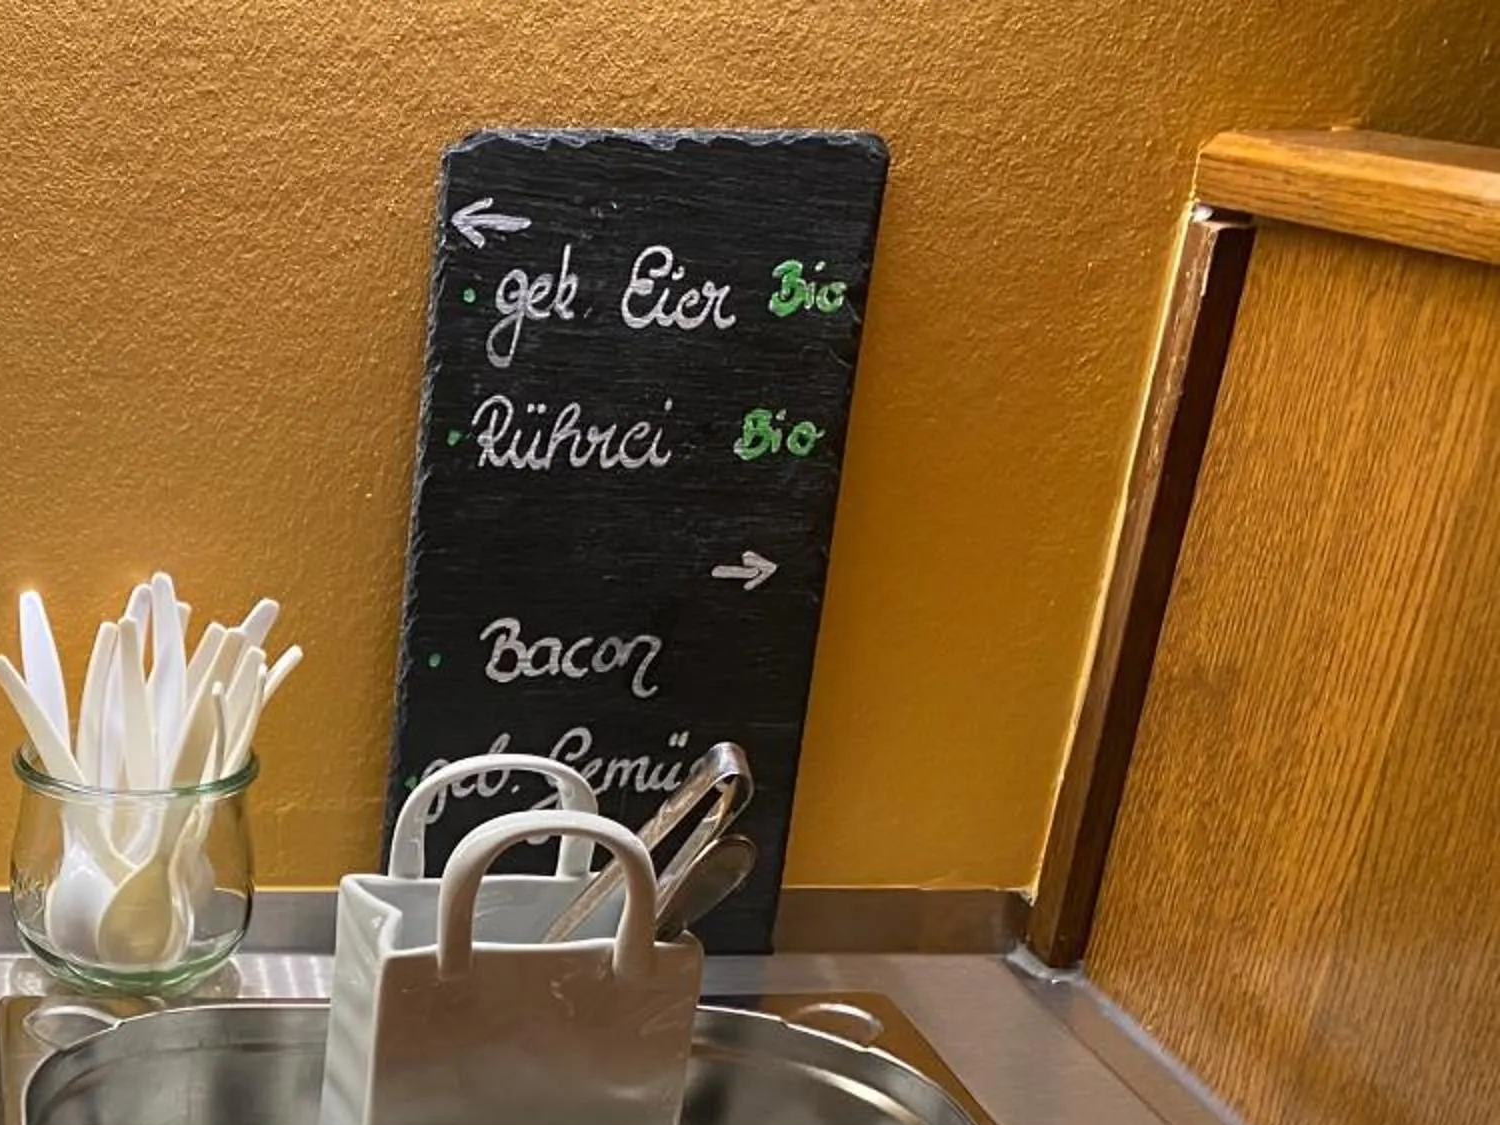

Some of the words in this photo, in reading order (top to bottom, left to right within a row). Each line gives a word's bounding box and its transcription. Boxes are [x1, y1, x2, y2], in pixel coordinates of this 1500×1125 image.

[621, 244, 738, 331] Eier
[768, 258, 847, 318] Bio
[471, 394, 674, 470] Rührei
[733, 408, 825, 462] Bio
[479, 617, 663, 699] Bacon
